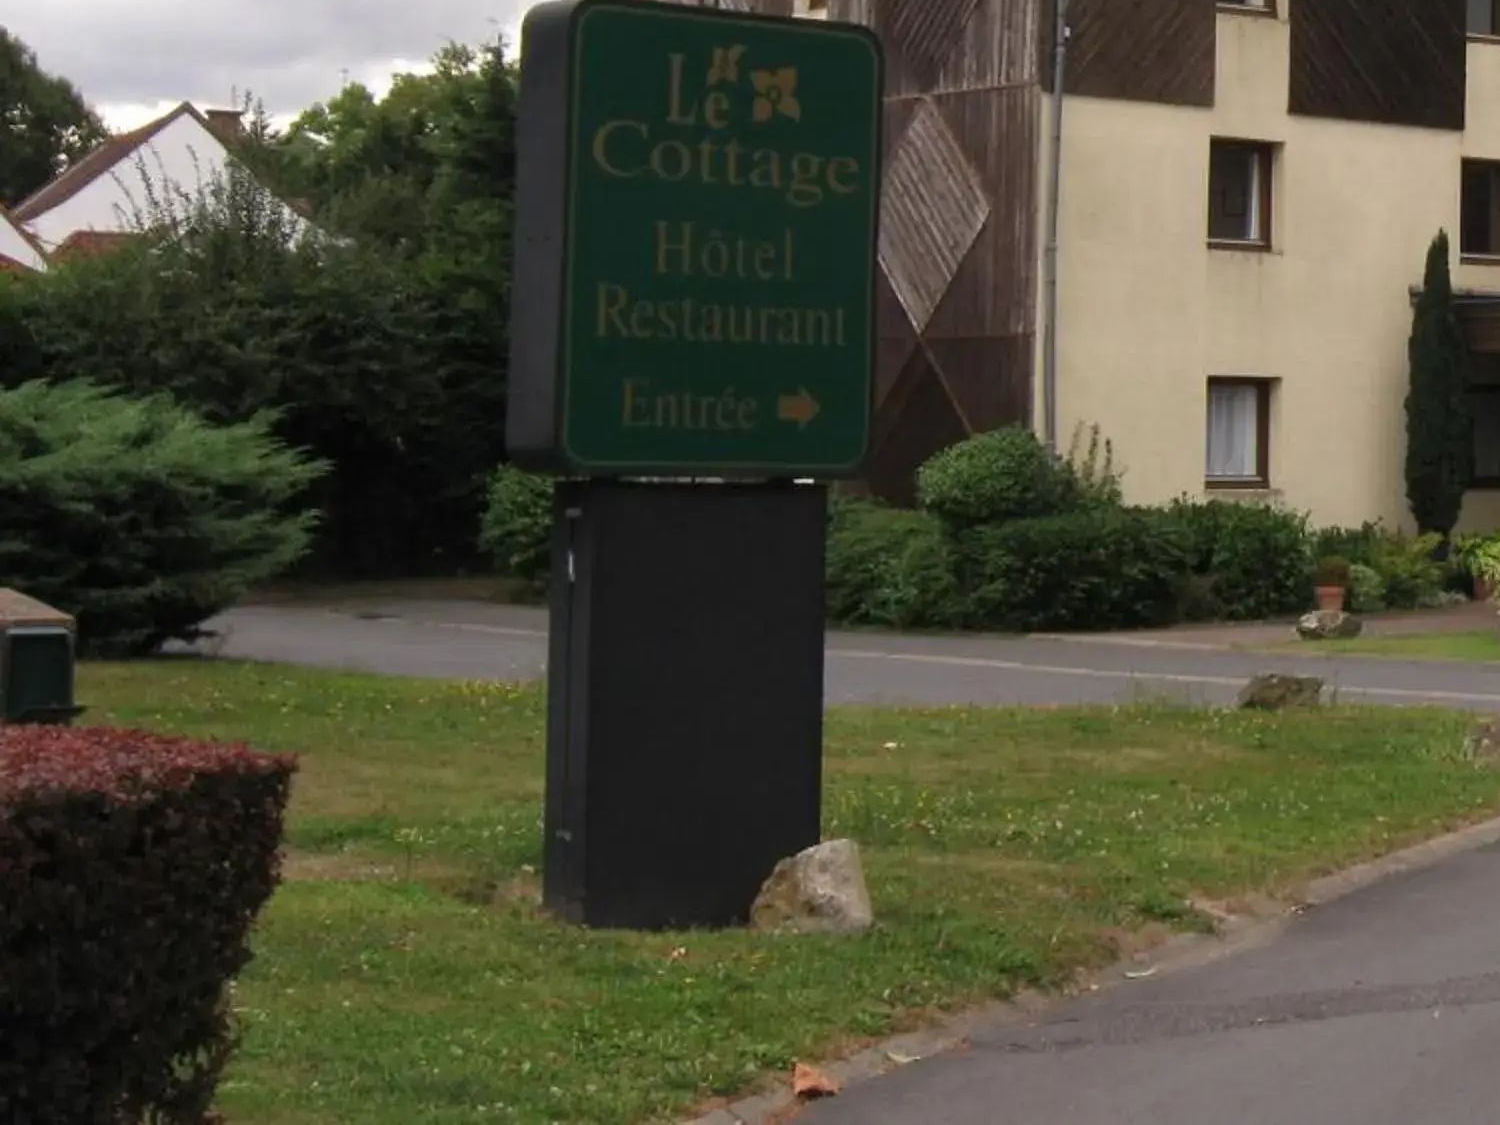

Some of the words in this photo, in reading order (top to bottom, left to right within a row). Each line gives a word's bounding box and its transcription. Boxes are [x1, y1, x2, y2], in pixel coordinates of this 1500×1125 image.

[666, 51, 730, 128] Le
[592, 118, 861, 208] Cottage
[653, 219, 797, 282] Hôtel
[594, 280, 848, 347] Restaurant
[620, 376, 759, 430] Entrée
